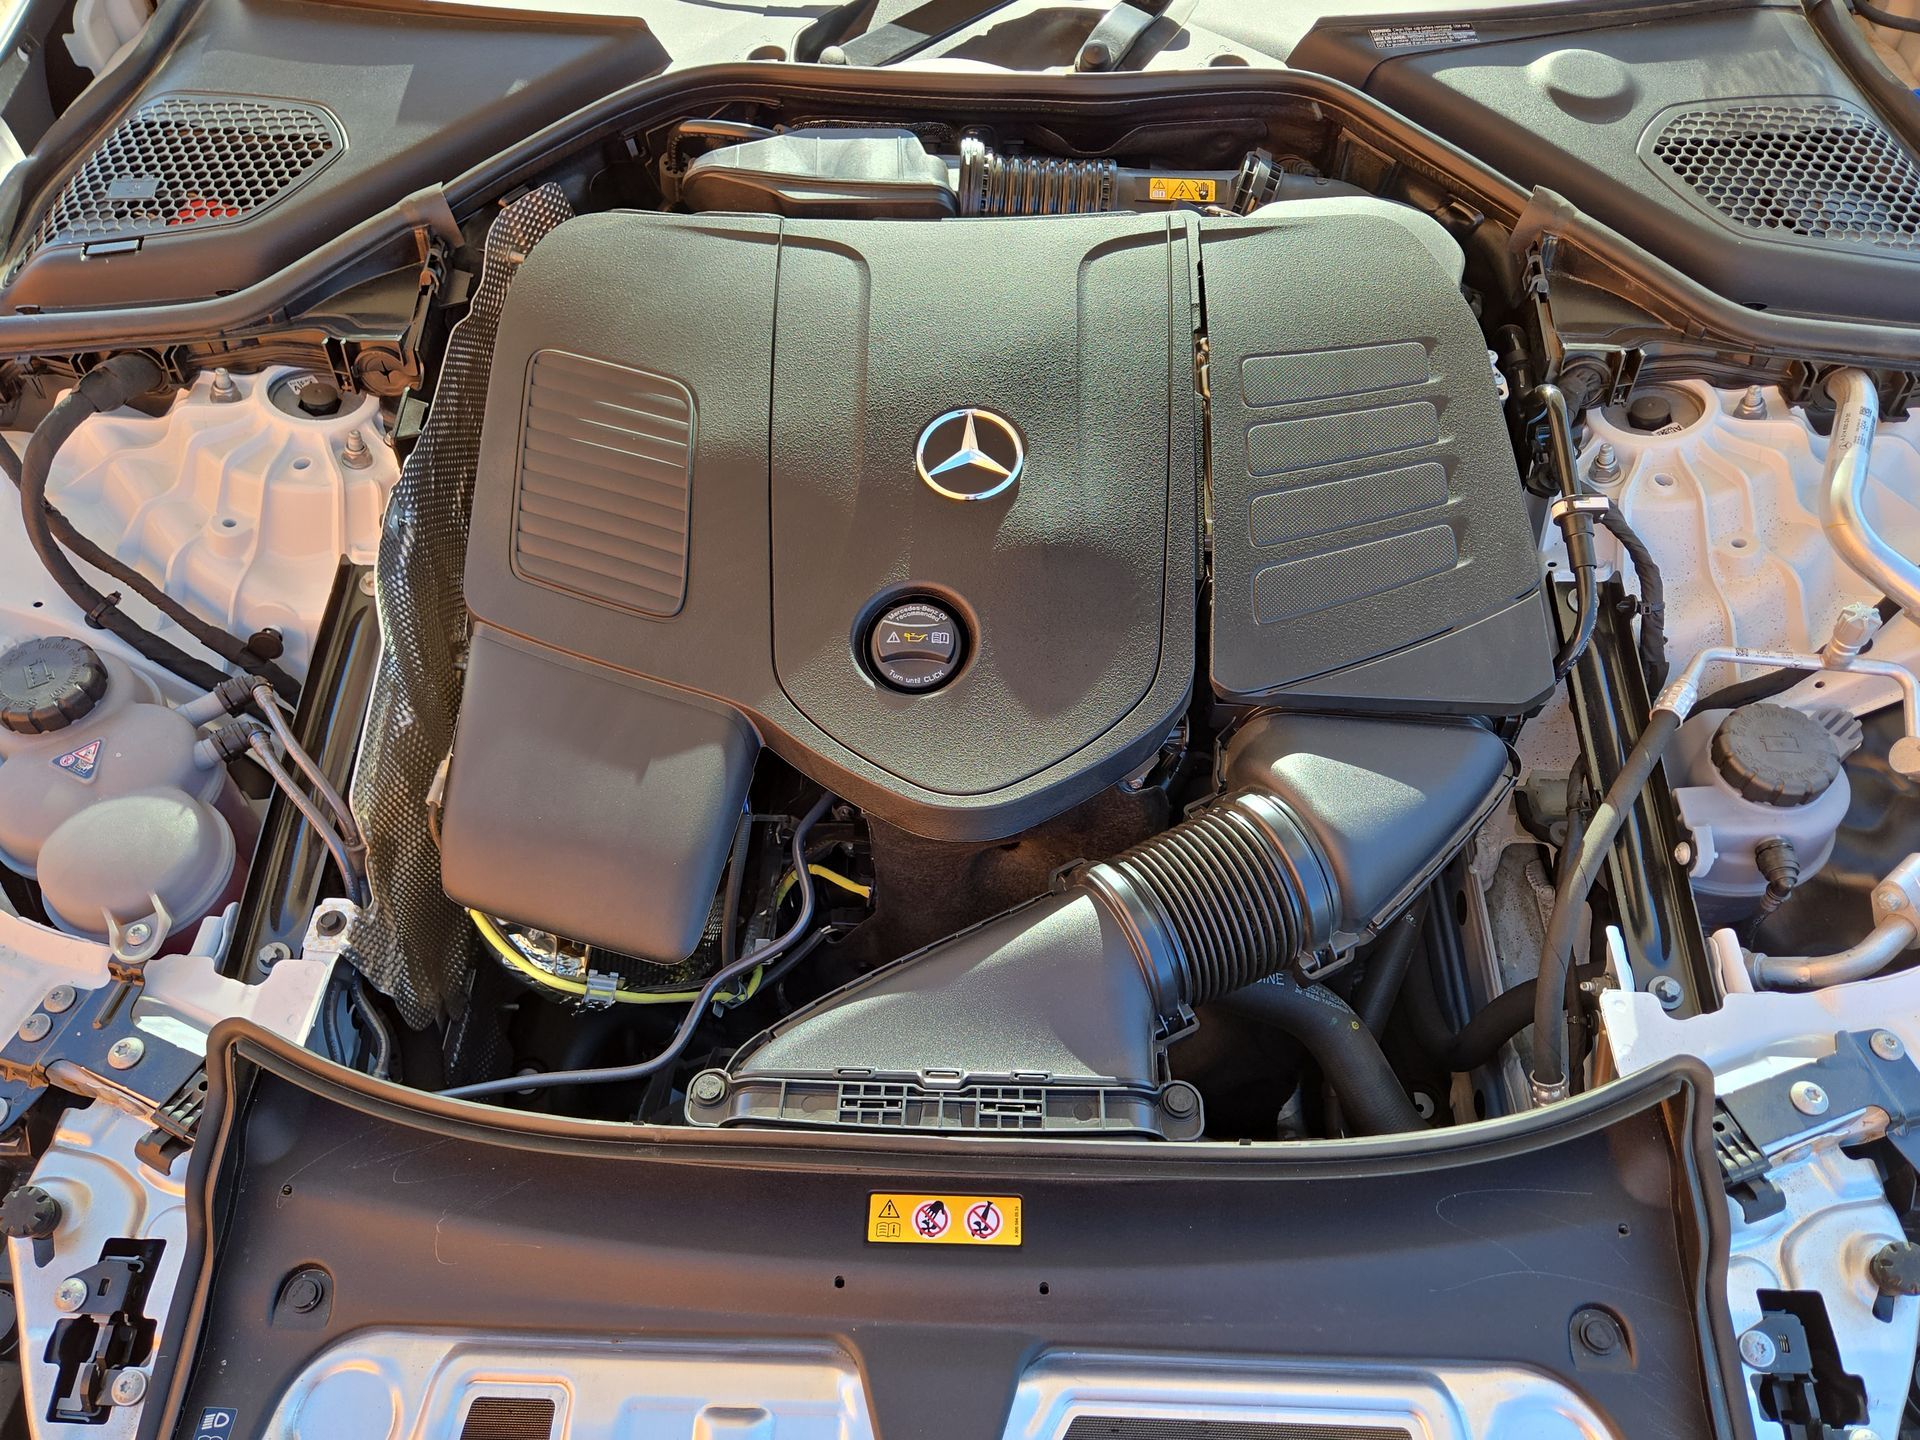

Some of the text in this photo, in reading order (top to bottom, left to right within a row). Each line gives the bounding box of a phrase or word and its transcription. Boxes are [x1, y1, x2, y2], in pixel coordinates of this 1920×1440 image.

[888, 605, 938, 619] Mercedes-Benz
[896, 611, 940, 622] recommended
[888, 669, 945, 684] Turn until CLICK
